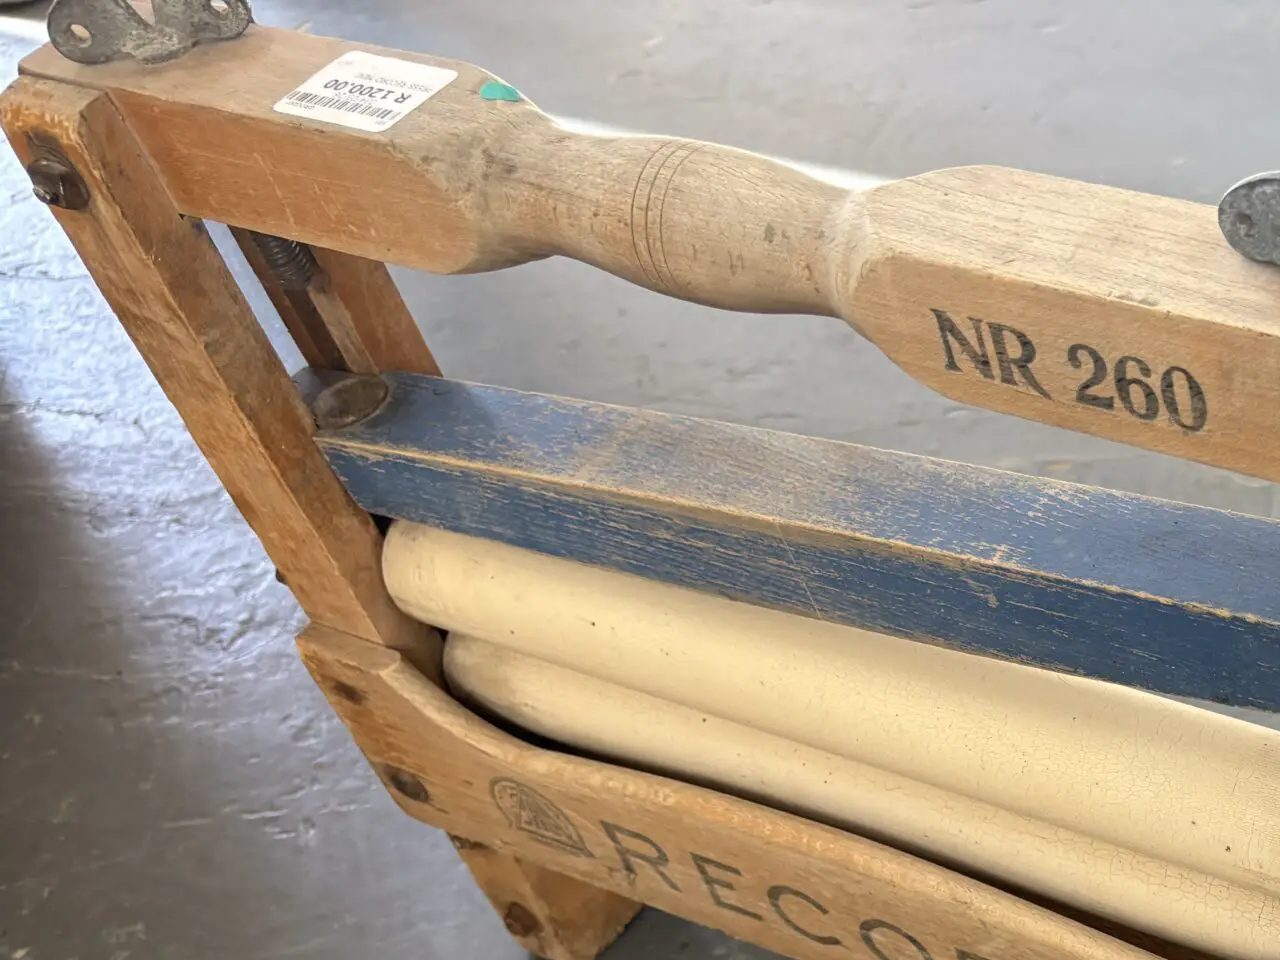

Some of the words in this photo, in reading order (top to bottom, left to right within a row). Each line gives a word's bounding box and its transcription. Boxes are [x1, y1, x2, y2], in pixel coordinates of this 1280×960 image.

[323, 79, 395, 100] 1200.00
[394, 92, 412, 104] R
[929, 308, 1053, 401] NR
[1067, 343, 1208, 433] 260
